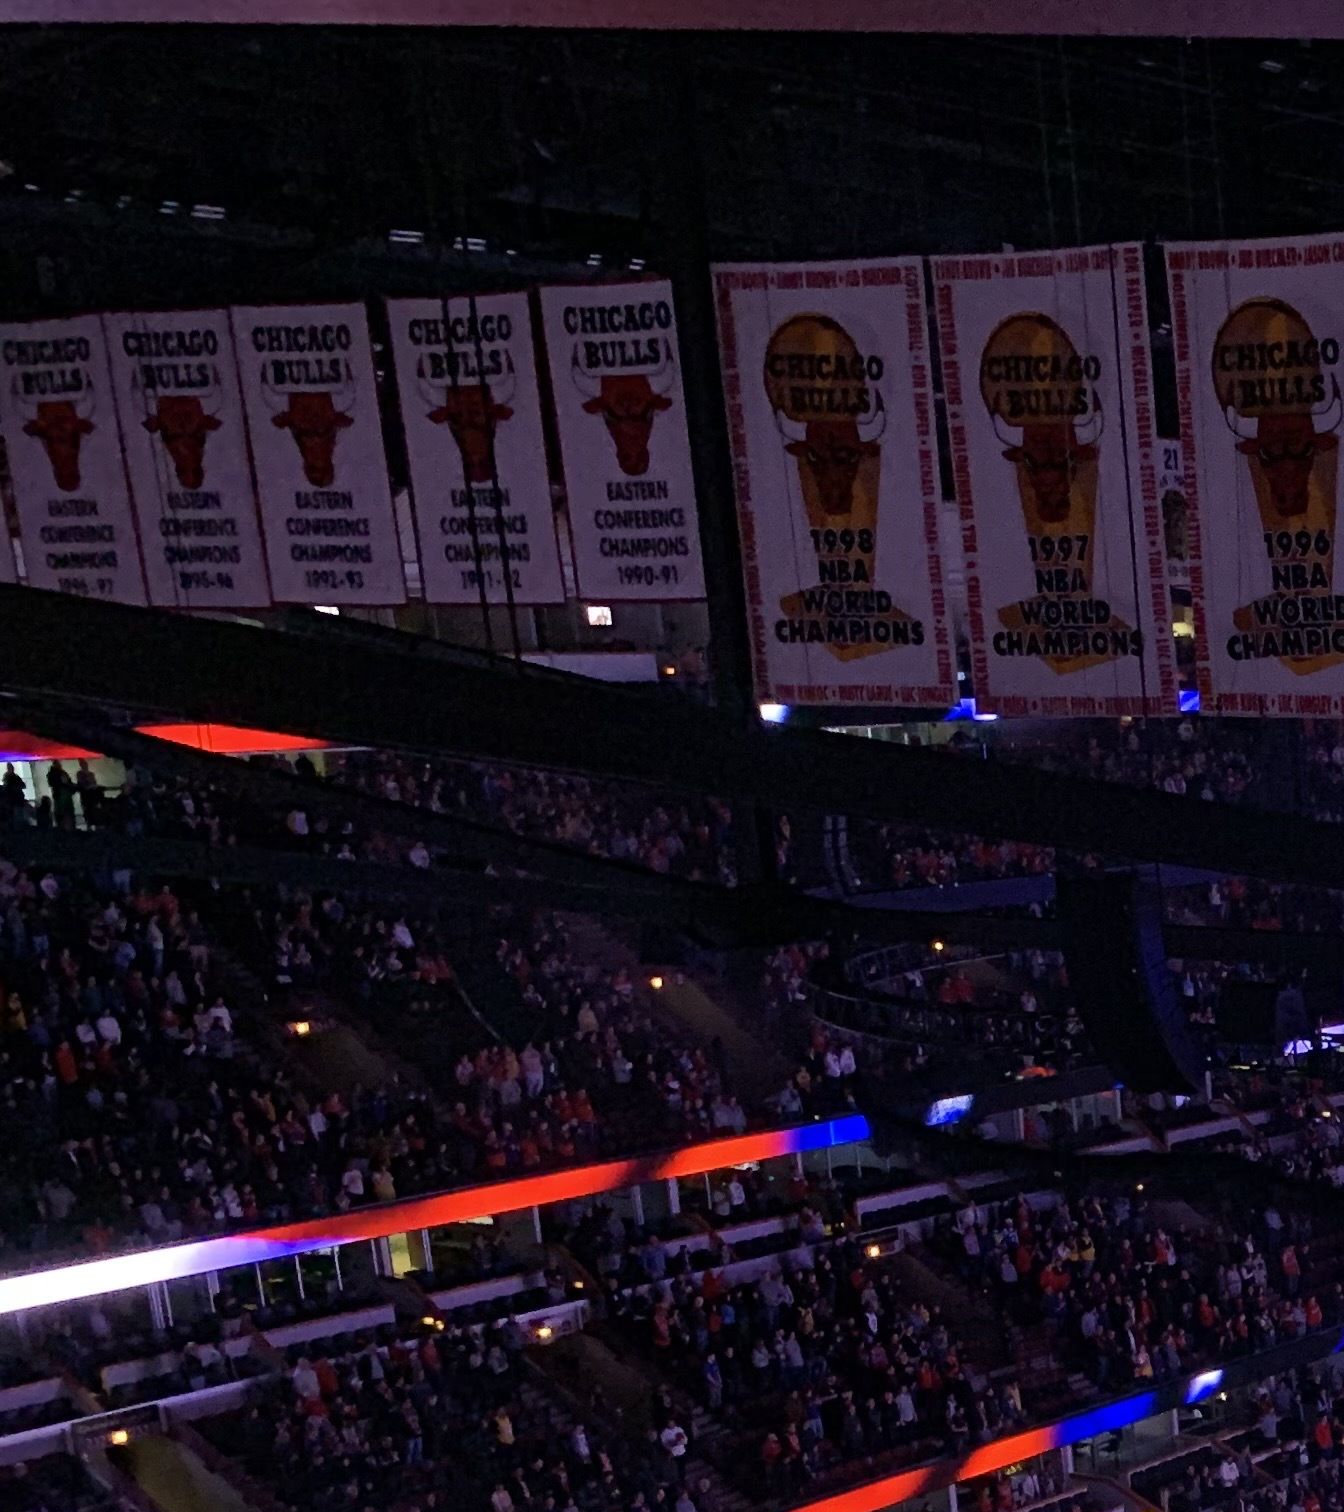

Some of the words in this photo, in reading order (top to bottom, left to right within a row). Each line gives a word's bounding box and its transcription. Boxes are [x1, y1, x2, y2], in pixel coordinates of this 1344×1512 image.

[409, 314, 512, 345] CHICAGO
[564, 302, 672, 334] CHICAGO
[123, 330, 218, 357] CHICAGO
[252, 325, 350, 352] CHICAGO
[585, 338, 660, 368] BULLS
[1219, 337, 1339, 369] CHICAGO
[143, 363, 209, 388] BULLS
[273, 358, 340, 385] BULLS
[768, 353, 884, 382] CHICAGO
[986, 355, 1101, 384] CHICAGO
[23, 368, 82, 395] BULLS
[1238, 373, 1326, 410] BULLS
[791, 386, 871, 415] BULLS
[1008, 386, 1087, 418] BULLS
[607, 481, 668, 502] EASTERN
[595, 508, 685, 530] CONFERENCE
[599, 536, 689, 558] CHAMPIONS
[810, 528, 873, 554] 1998
[1028, 535, 1088, 562] 1997
[1264, 531, 1330, 558] 1996
[618, 565, 679, 584] 1990-91
[818, 557, 868, 583] NBA
[1036, 567, 1087, 593] NBA
[1272, 562, 1327, 590] NBA
[802, 589, 891, 615] WORLD
[1019, 599, 1109, 626] WORLD
[775, 617, 924, 645] CHAMPIONS
[993, 628, 1143, 656] CHAMPIONS
